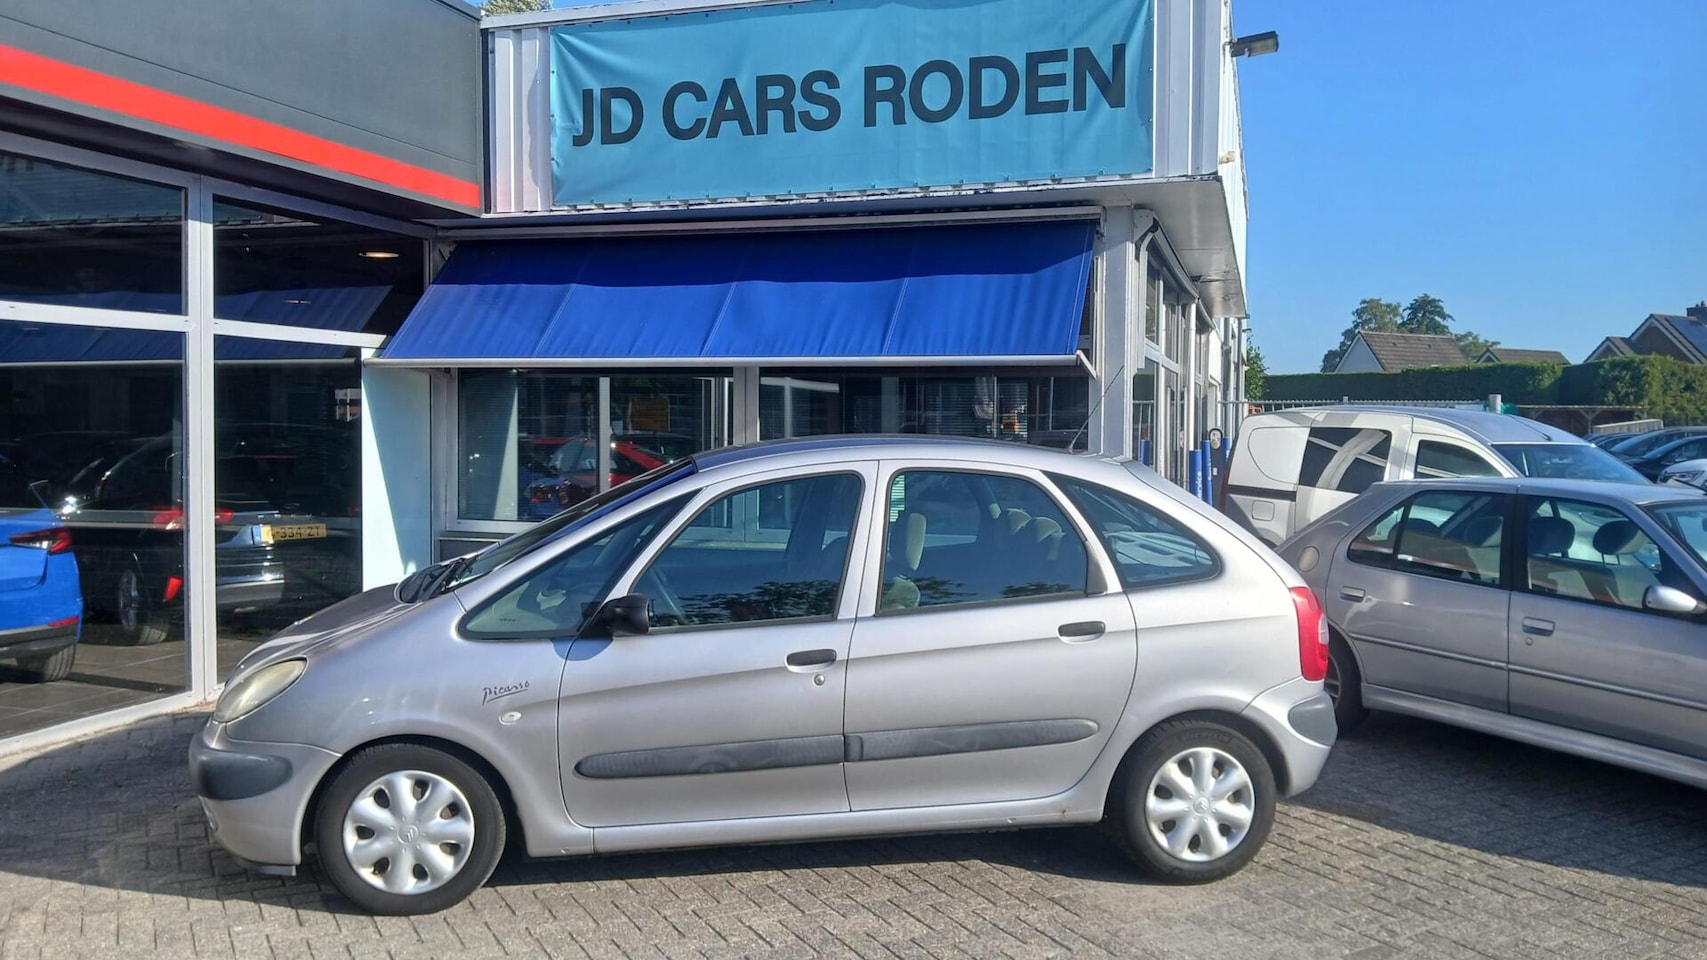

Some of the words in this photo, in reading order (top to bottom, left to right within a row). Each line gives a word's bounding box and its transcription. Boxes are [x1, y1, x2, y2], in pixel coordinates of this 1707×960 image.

[572, 87, 644, 147] JD
[662, 70, 841, 140] CARS
[863, 43, 1127, 128] RODEN
[482, 680, 530, 706] Picasso
